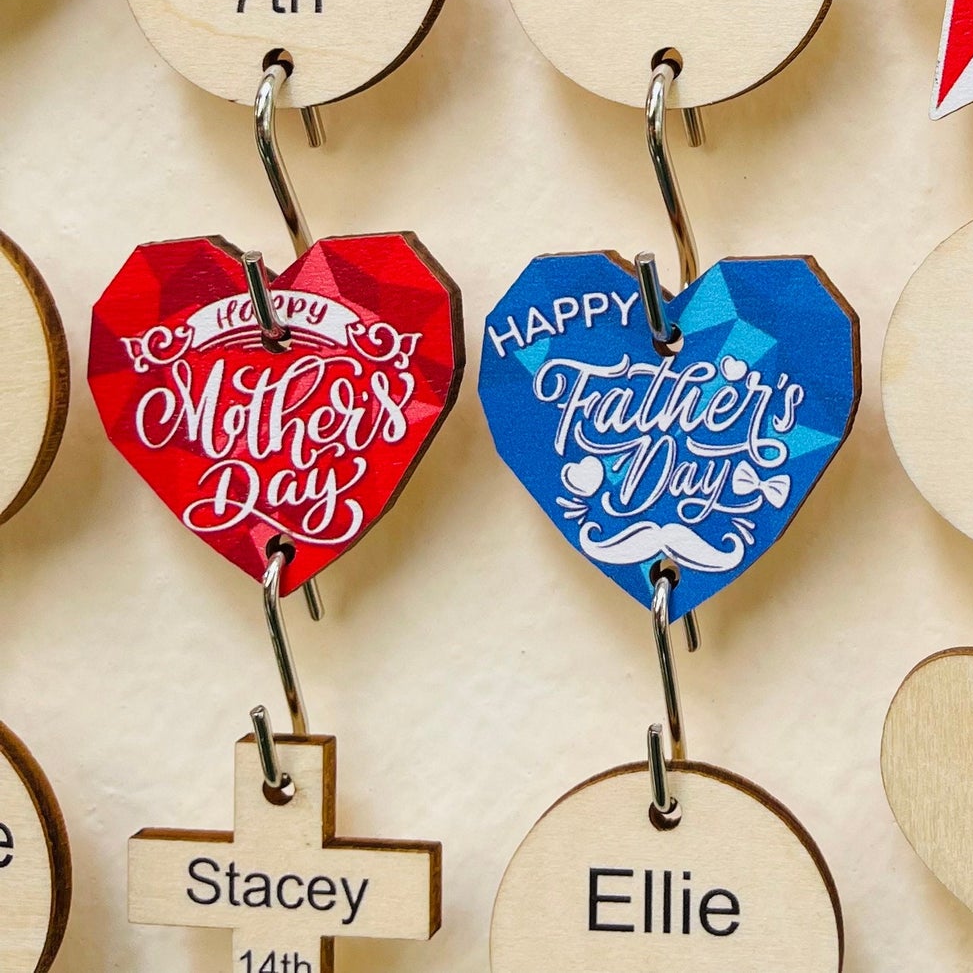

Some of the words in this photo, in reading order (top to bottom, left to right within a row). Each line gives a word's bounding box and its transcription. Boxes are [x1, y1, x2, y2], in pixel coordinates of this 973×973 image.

[488, 291, 639, 357] HAPPY
[136, 355, 415, 469] Mother's
[533, 354, 804, 468] Father's
[183, 457, 363, 544] Day
[601, 435, 762, 524] Day
[187, 857, 369, 925] Stacey
[588, 867, 741, 937] Ellie
